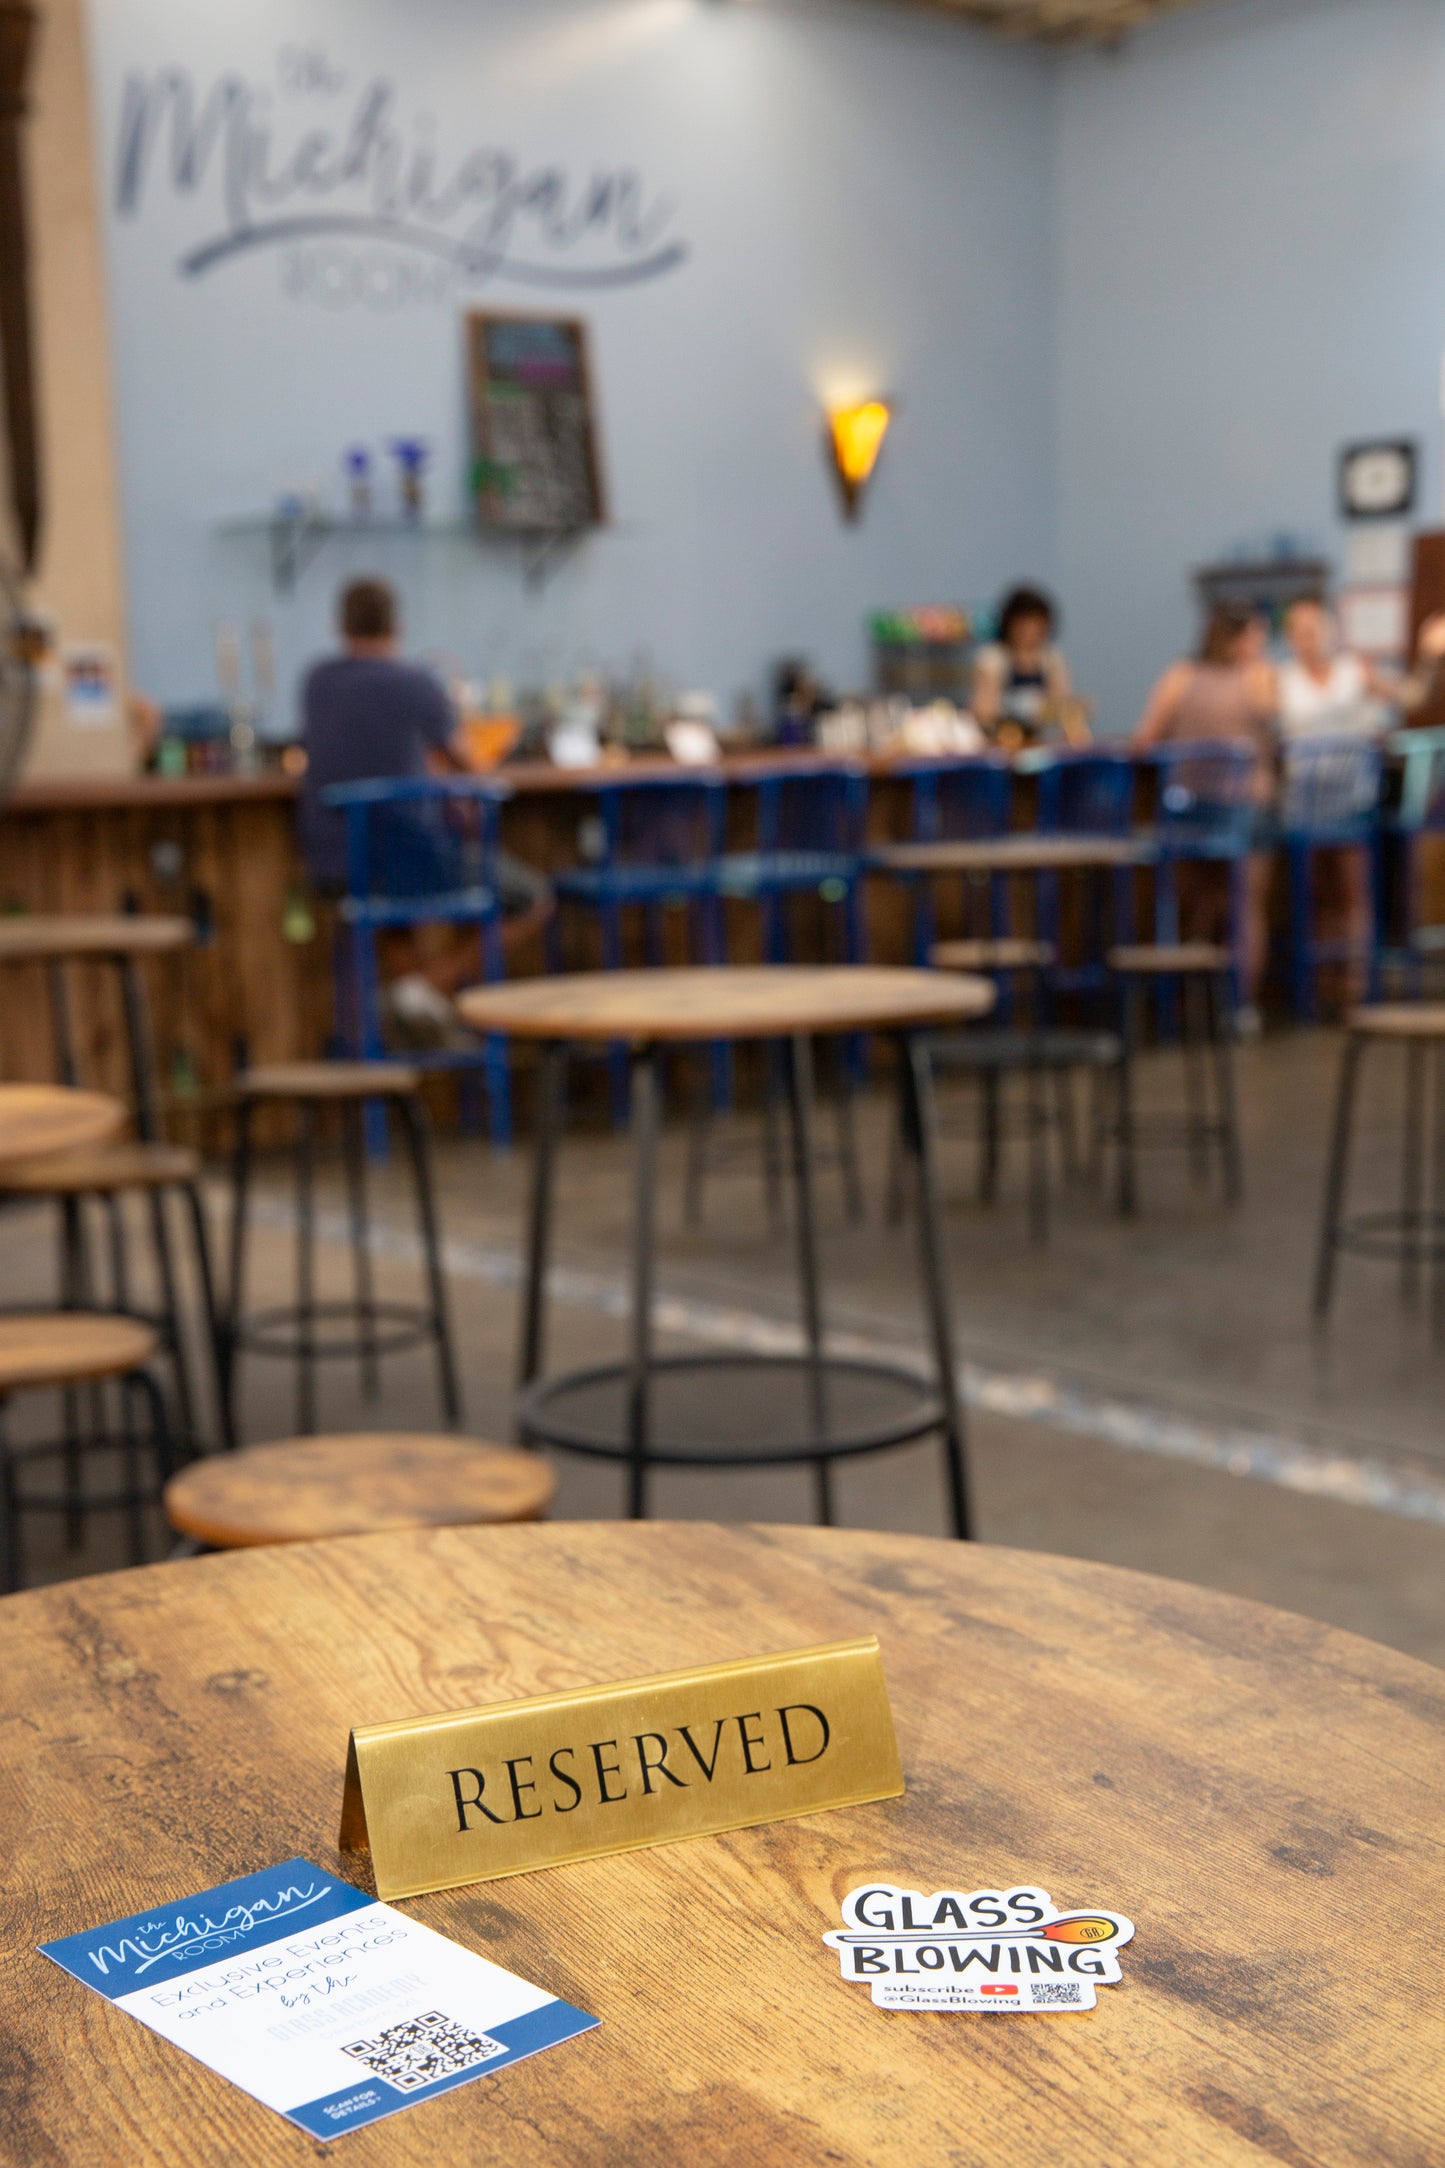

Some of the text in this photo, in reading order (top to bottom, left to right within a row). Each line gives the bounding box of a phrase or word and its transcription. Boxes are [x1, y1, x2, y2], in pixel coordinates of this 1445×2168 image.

[113, 62, 676, 284] Michigan
[445, 1703, 831, 1833] RESERVED
[87, 1882, 315, 1975] Michigan
[854, 1890, 1044, 1931] GLASS
[150, 1916, 388, 2008] Exclusive Events
[171, 1930, 246, 1961] ROOM
[852, 1944, 1107, 1976] BLOWING
[178, 1927, 409, 2020] and Experiences
[280, 1974, 359, 2009] by the
[884, 1984, 975, 1994] subscribe
[884, 1995, 1021, 2006] @GlassBlowing
[266, 2009, 337, 2041] GLASS
